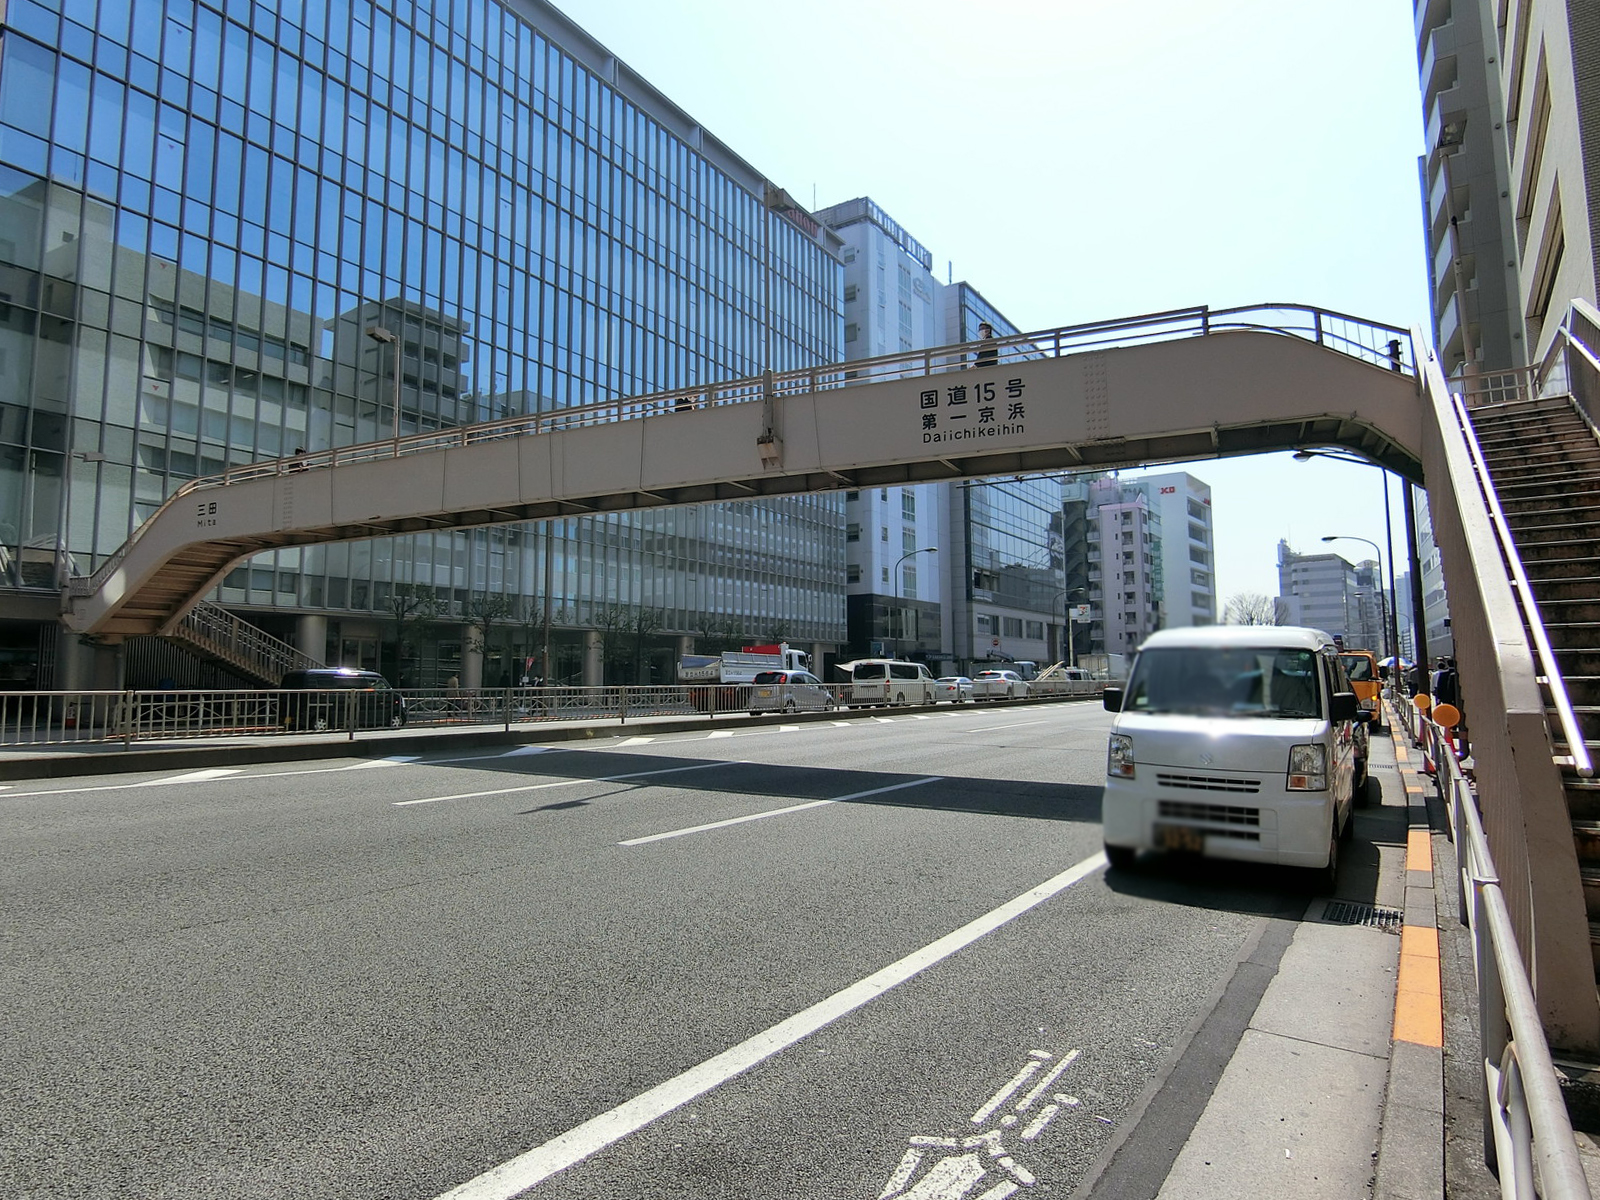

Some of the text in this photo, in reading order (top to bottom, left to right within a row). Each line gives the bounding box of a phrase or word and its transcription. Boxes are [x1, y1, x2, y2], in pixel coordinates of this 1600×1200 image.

[920, 378, 1026, 410] 国道15号
[922, 402, 1025, 430] 第一京浜
[923, 423, 1024, 443] Daiichikeihin
[197, 502, 217, 516] 三田
